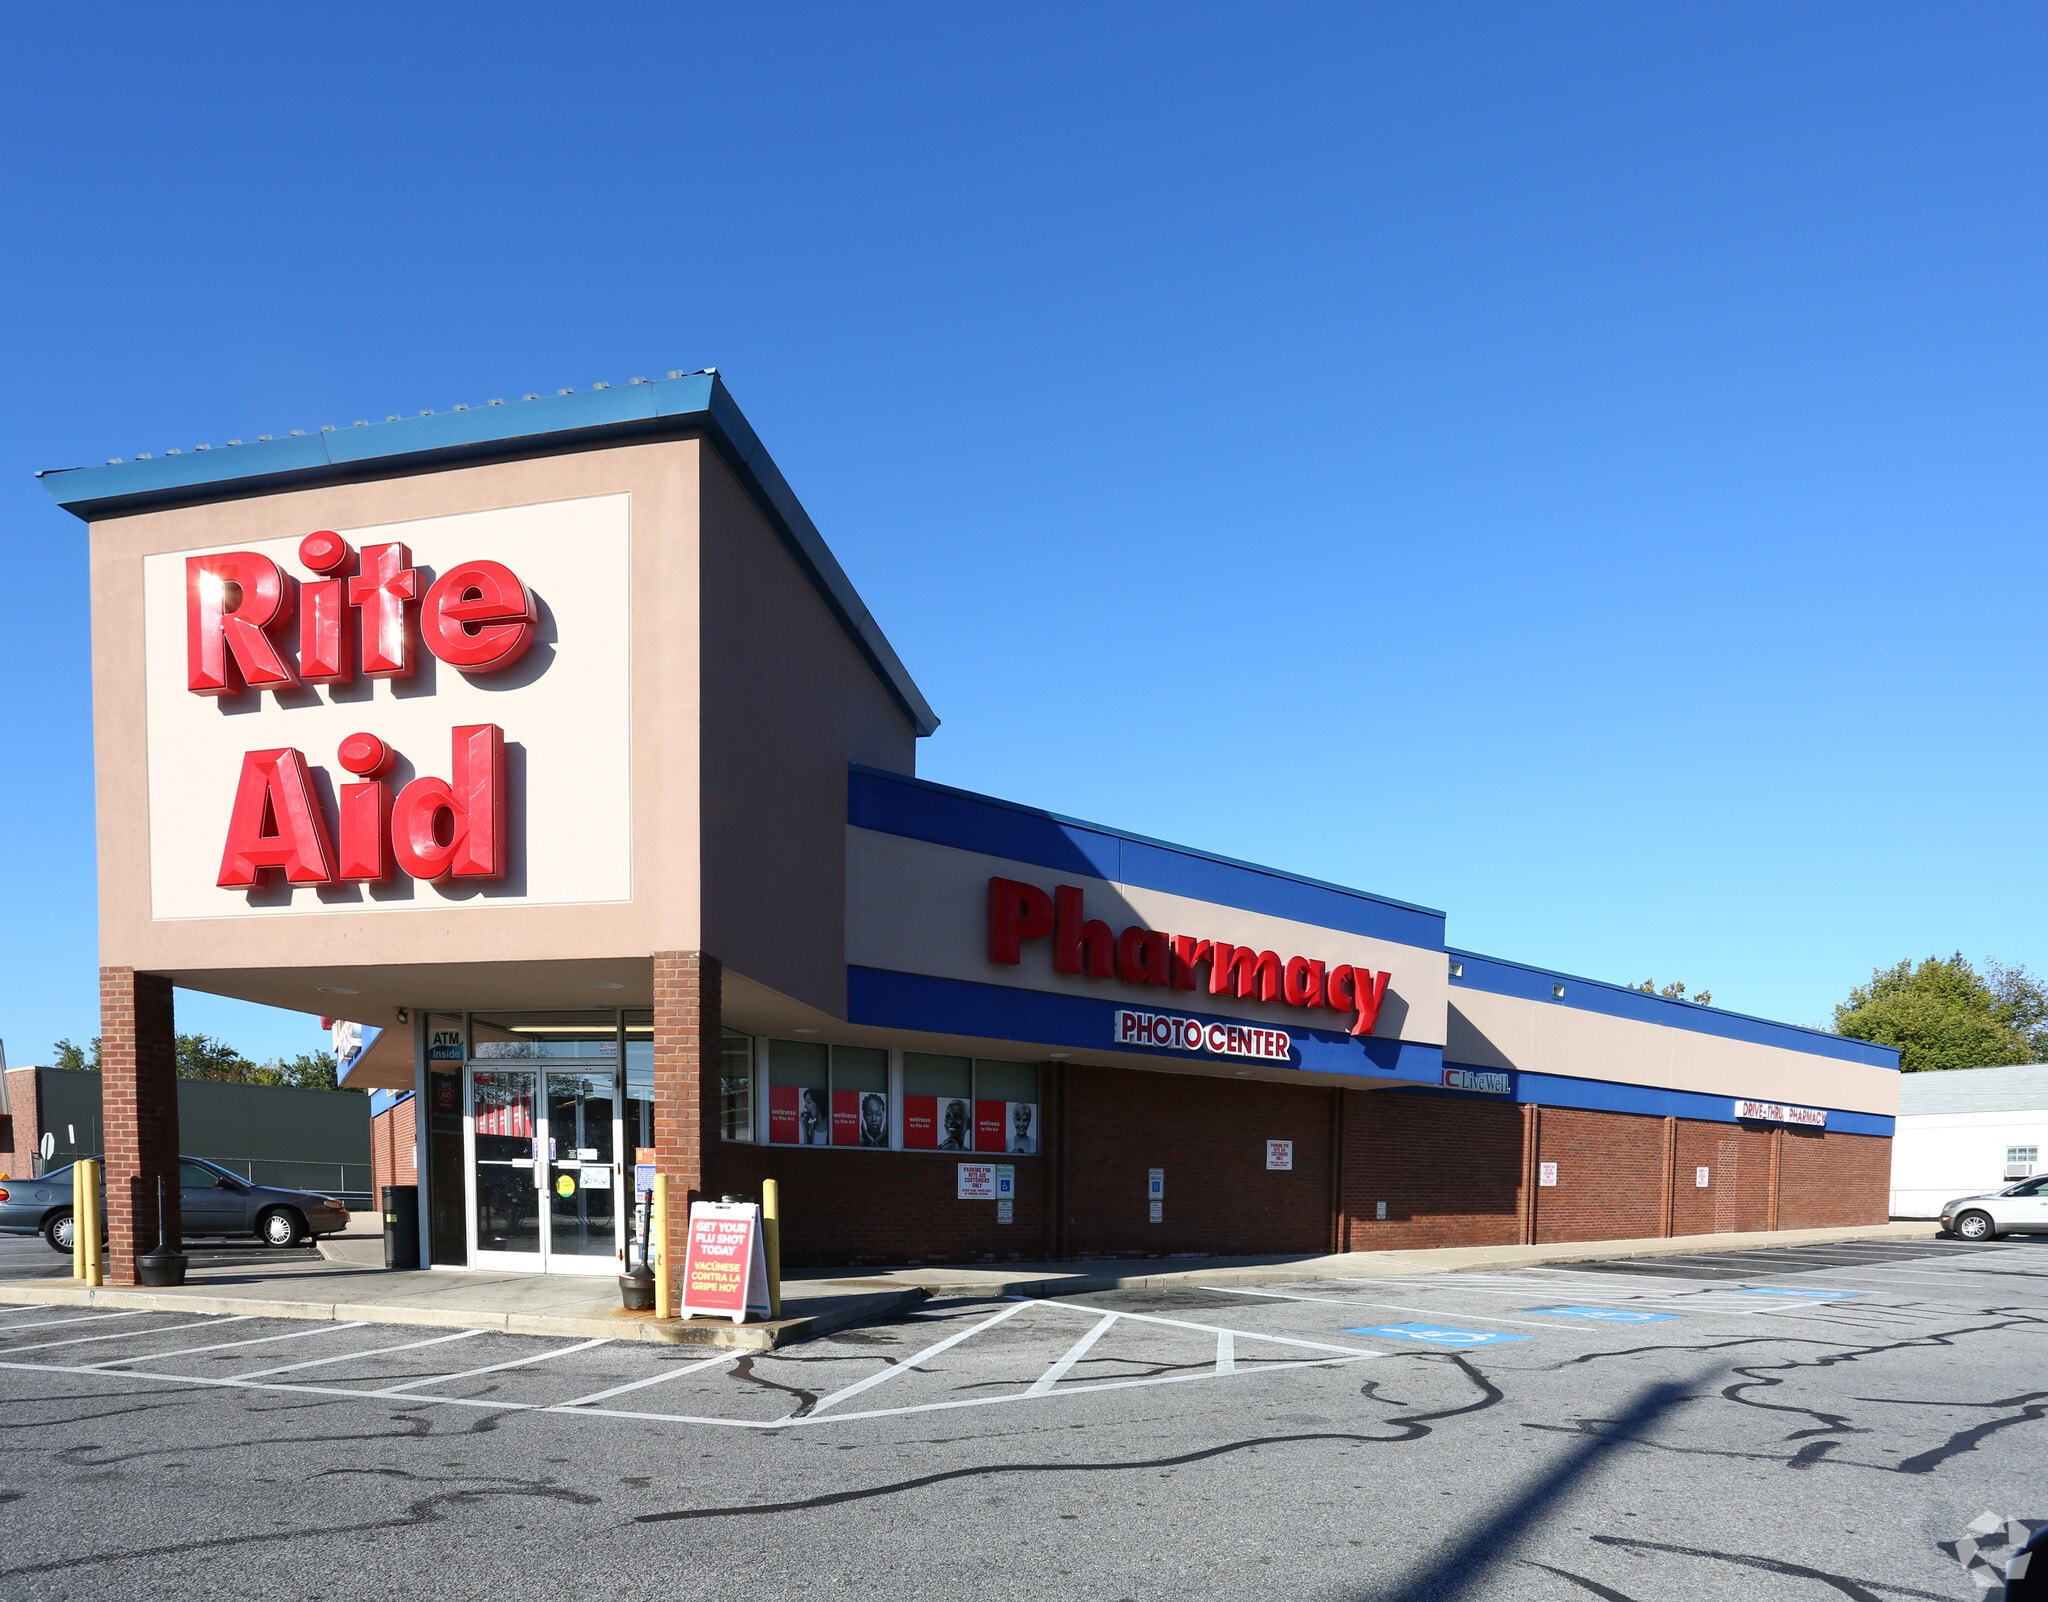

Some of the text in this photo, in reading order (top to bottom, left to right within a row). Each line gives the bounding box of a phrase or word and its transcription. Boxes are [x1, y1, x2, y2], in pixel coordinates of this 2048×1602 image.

[186, 530, 537, 696] Rite
[217, 723, 504, 889] Aid
[988, 876, 1392, 1035] Pharmacy
[433, 1032, 459, 1045] ATM
[1121, 1012, 1288, 1058] PHOTO CENTER
[433, 1049, 460, 1059] Inside
[1789, 1108, 1826, 1125] PHARMACY
[696, 1222, 748, 1233] GET YOUR
[695, 1233, 746, 1245] FLU SHOT
[701, 1245, 737, 1256] TODAY
[694, 1260, 741, 1272] VACÚNESE
[691, 1271, 741, 1282] CONTRA LA
[692, 1281, 739, 1293] GRIPE HOY
